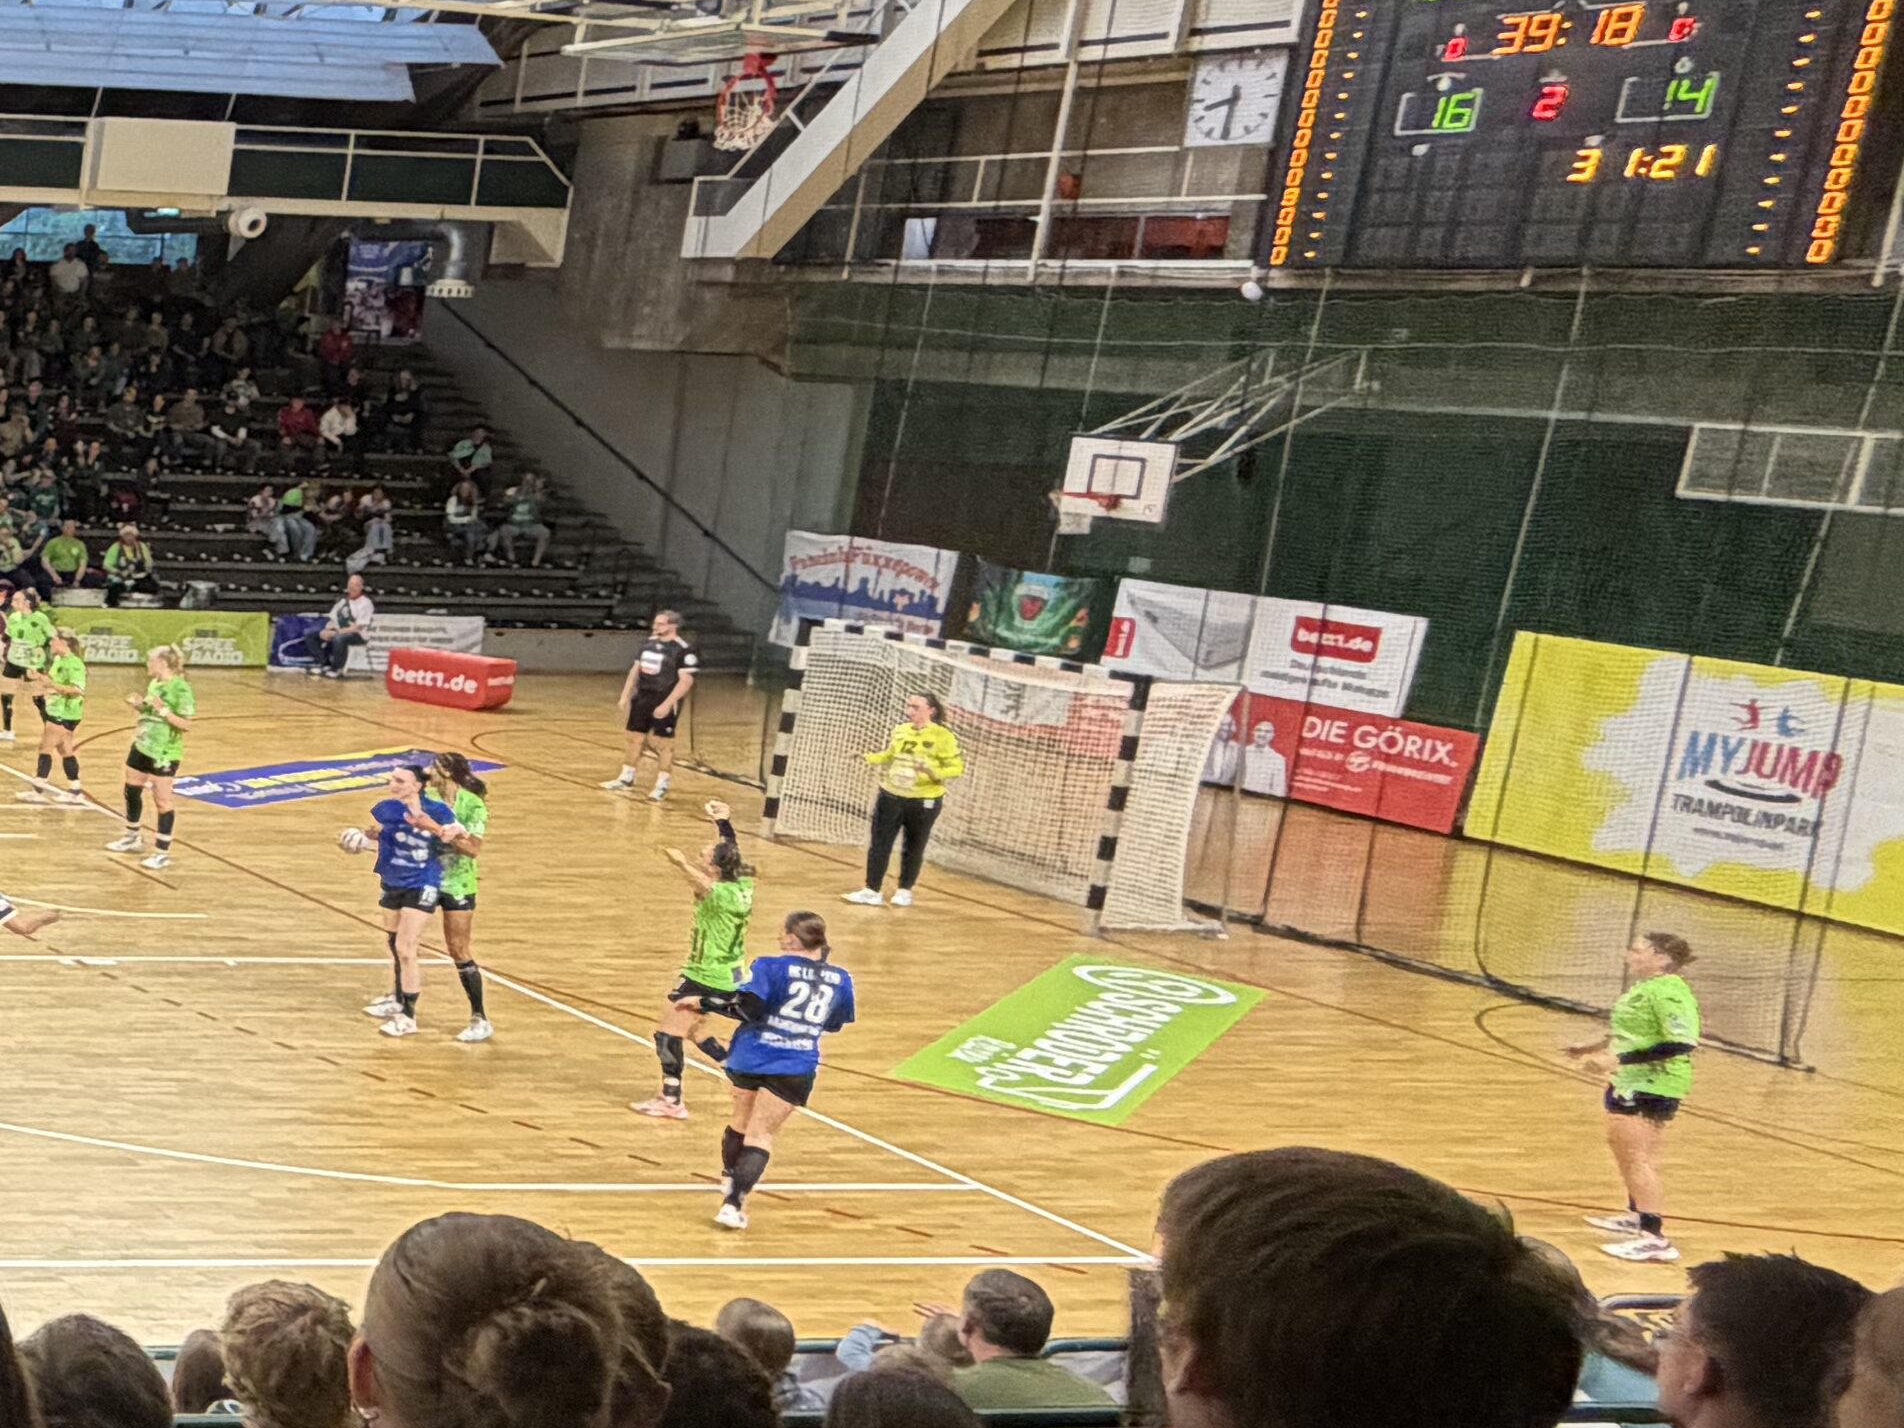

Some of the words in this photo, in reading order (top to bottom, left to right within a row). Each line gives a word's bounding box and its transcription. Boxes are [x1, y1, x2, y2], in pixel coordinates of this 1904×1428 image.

[1432, 91, 1478, 132] 16
[1532, 83, 1569, 121] 2
[392, 663, 478, 695] bett1.de
[1301, 715, 1348, 743] DIE
[779, 980, 834, 1024] 28
